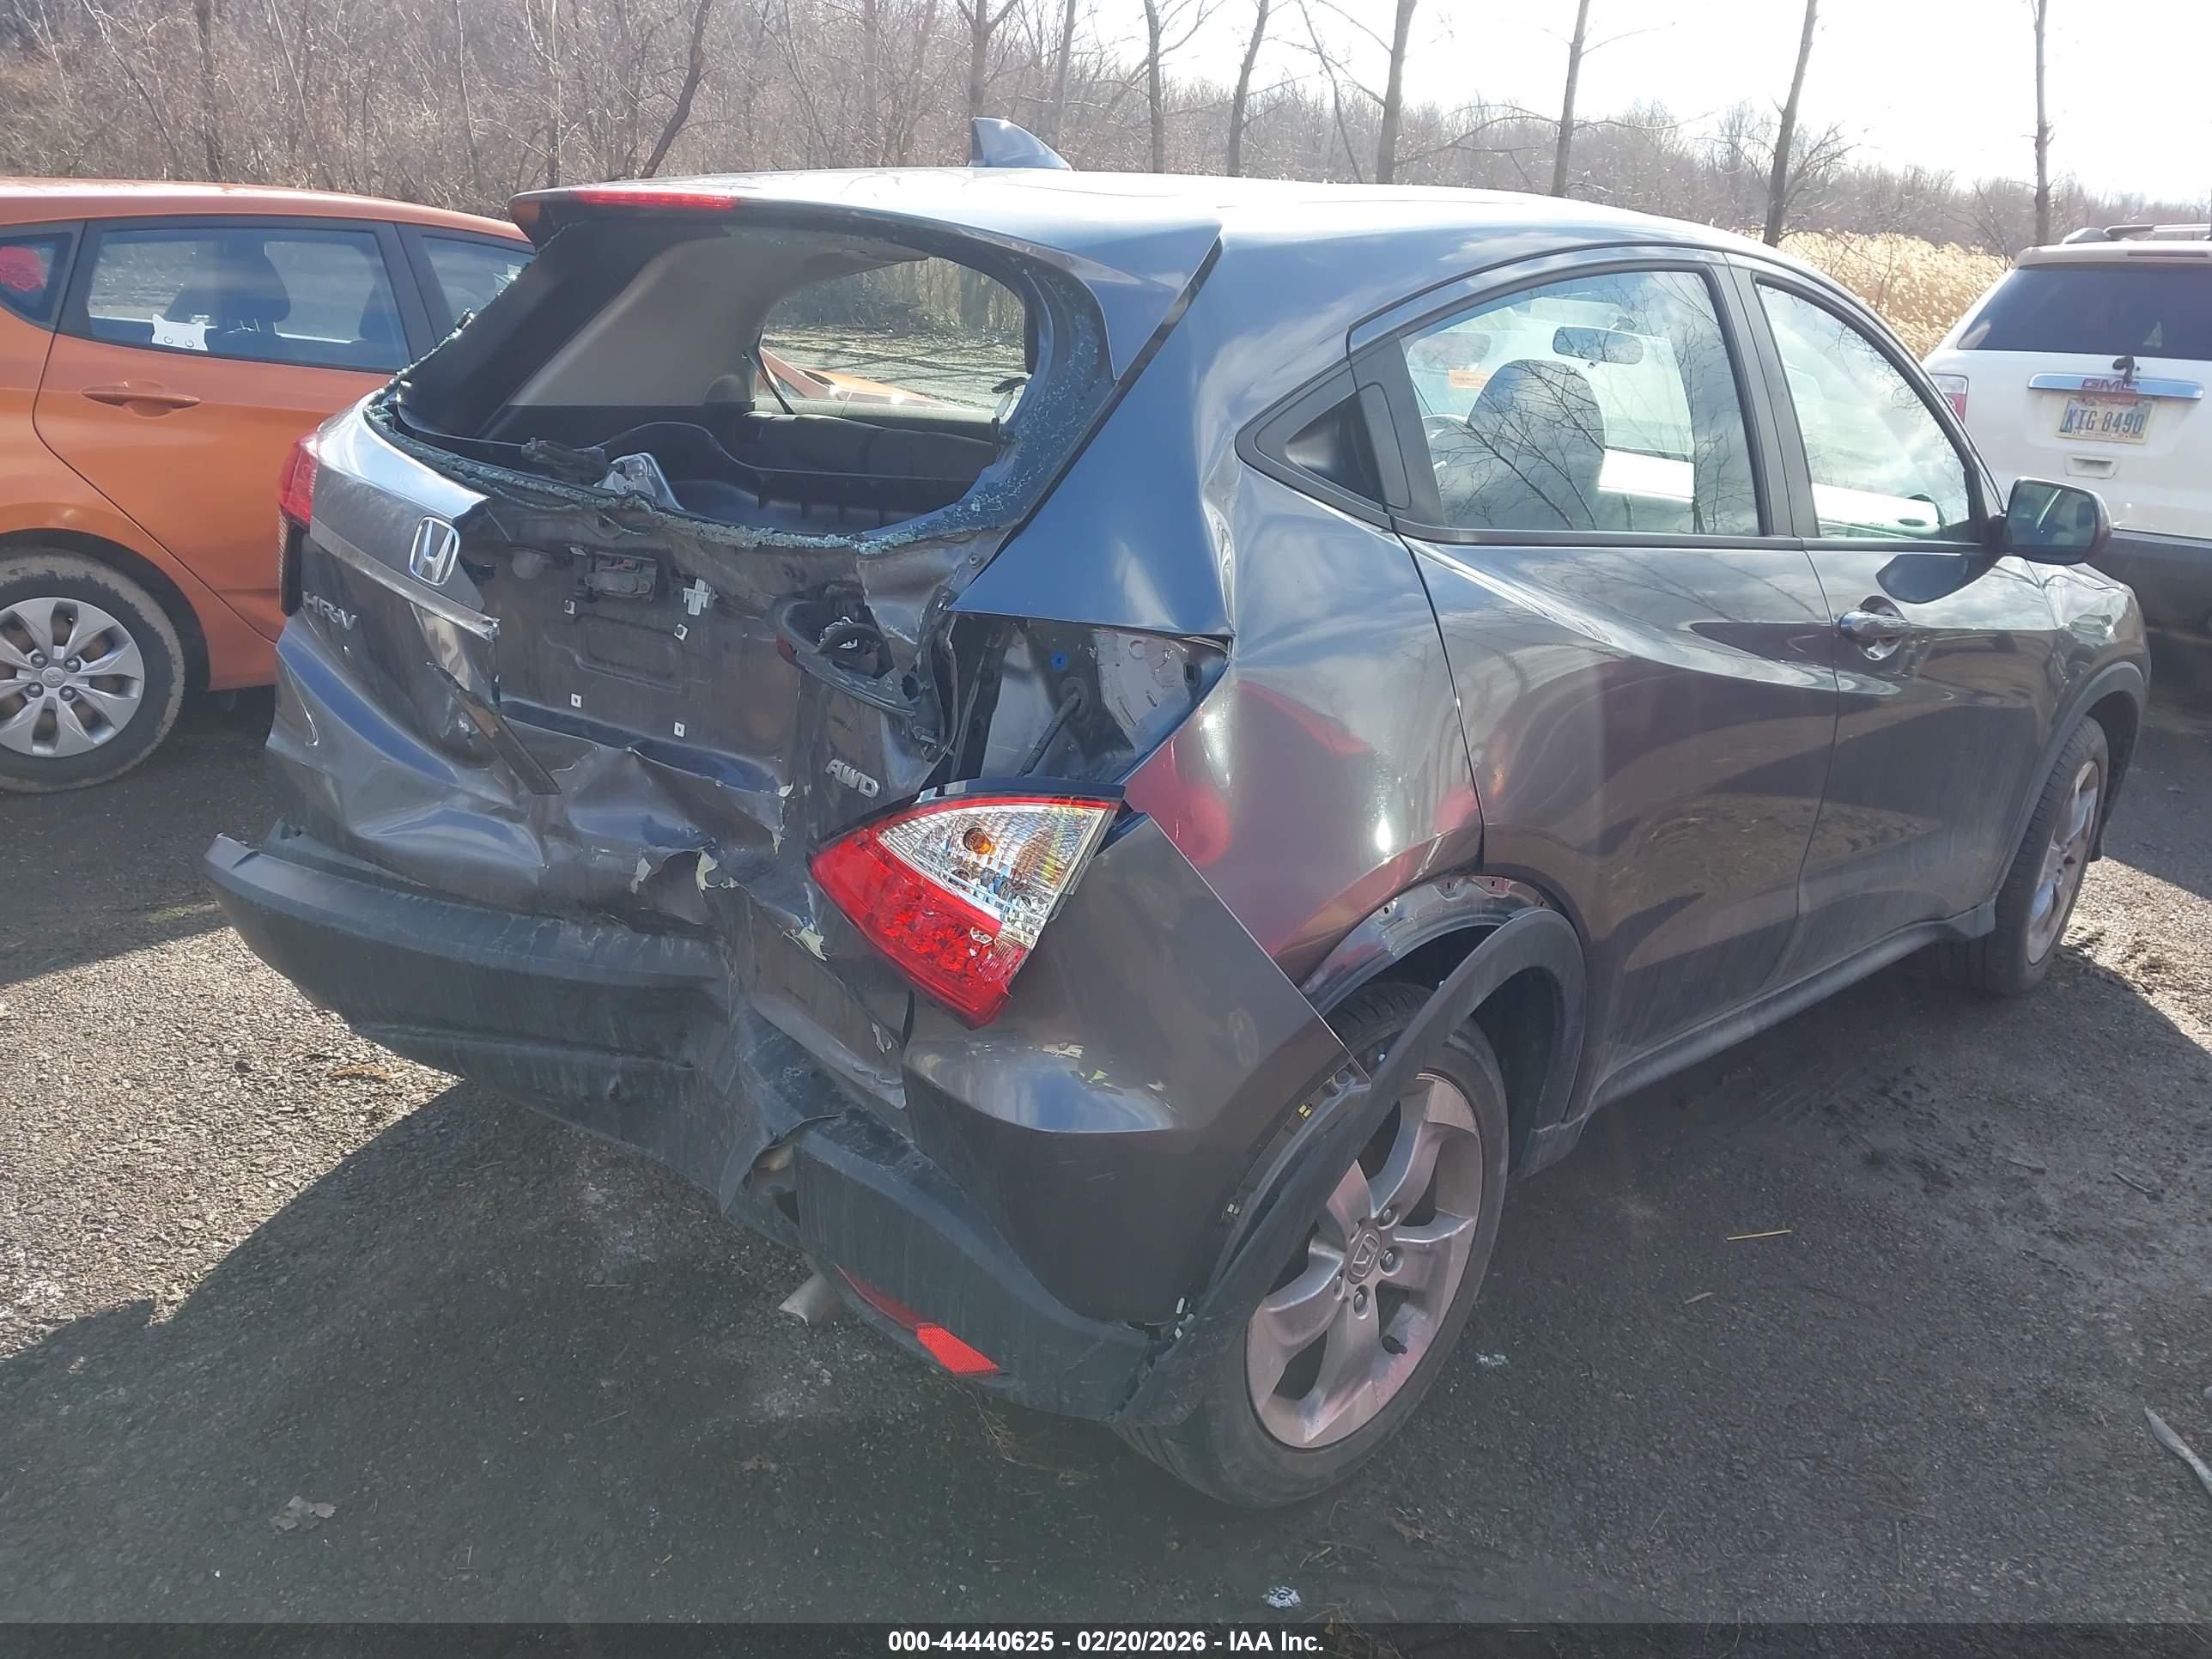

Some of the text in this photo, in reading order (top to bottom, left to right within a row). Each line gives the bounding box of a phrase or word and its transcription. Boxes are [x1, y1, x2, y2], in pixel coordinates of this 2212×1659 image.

[2081, 378, 2139, 392] GMC
[2101, 410, 2145, 434] 8490
[825, 759, 880, 798] AWD
